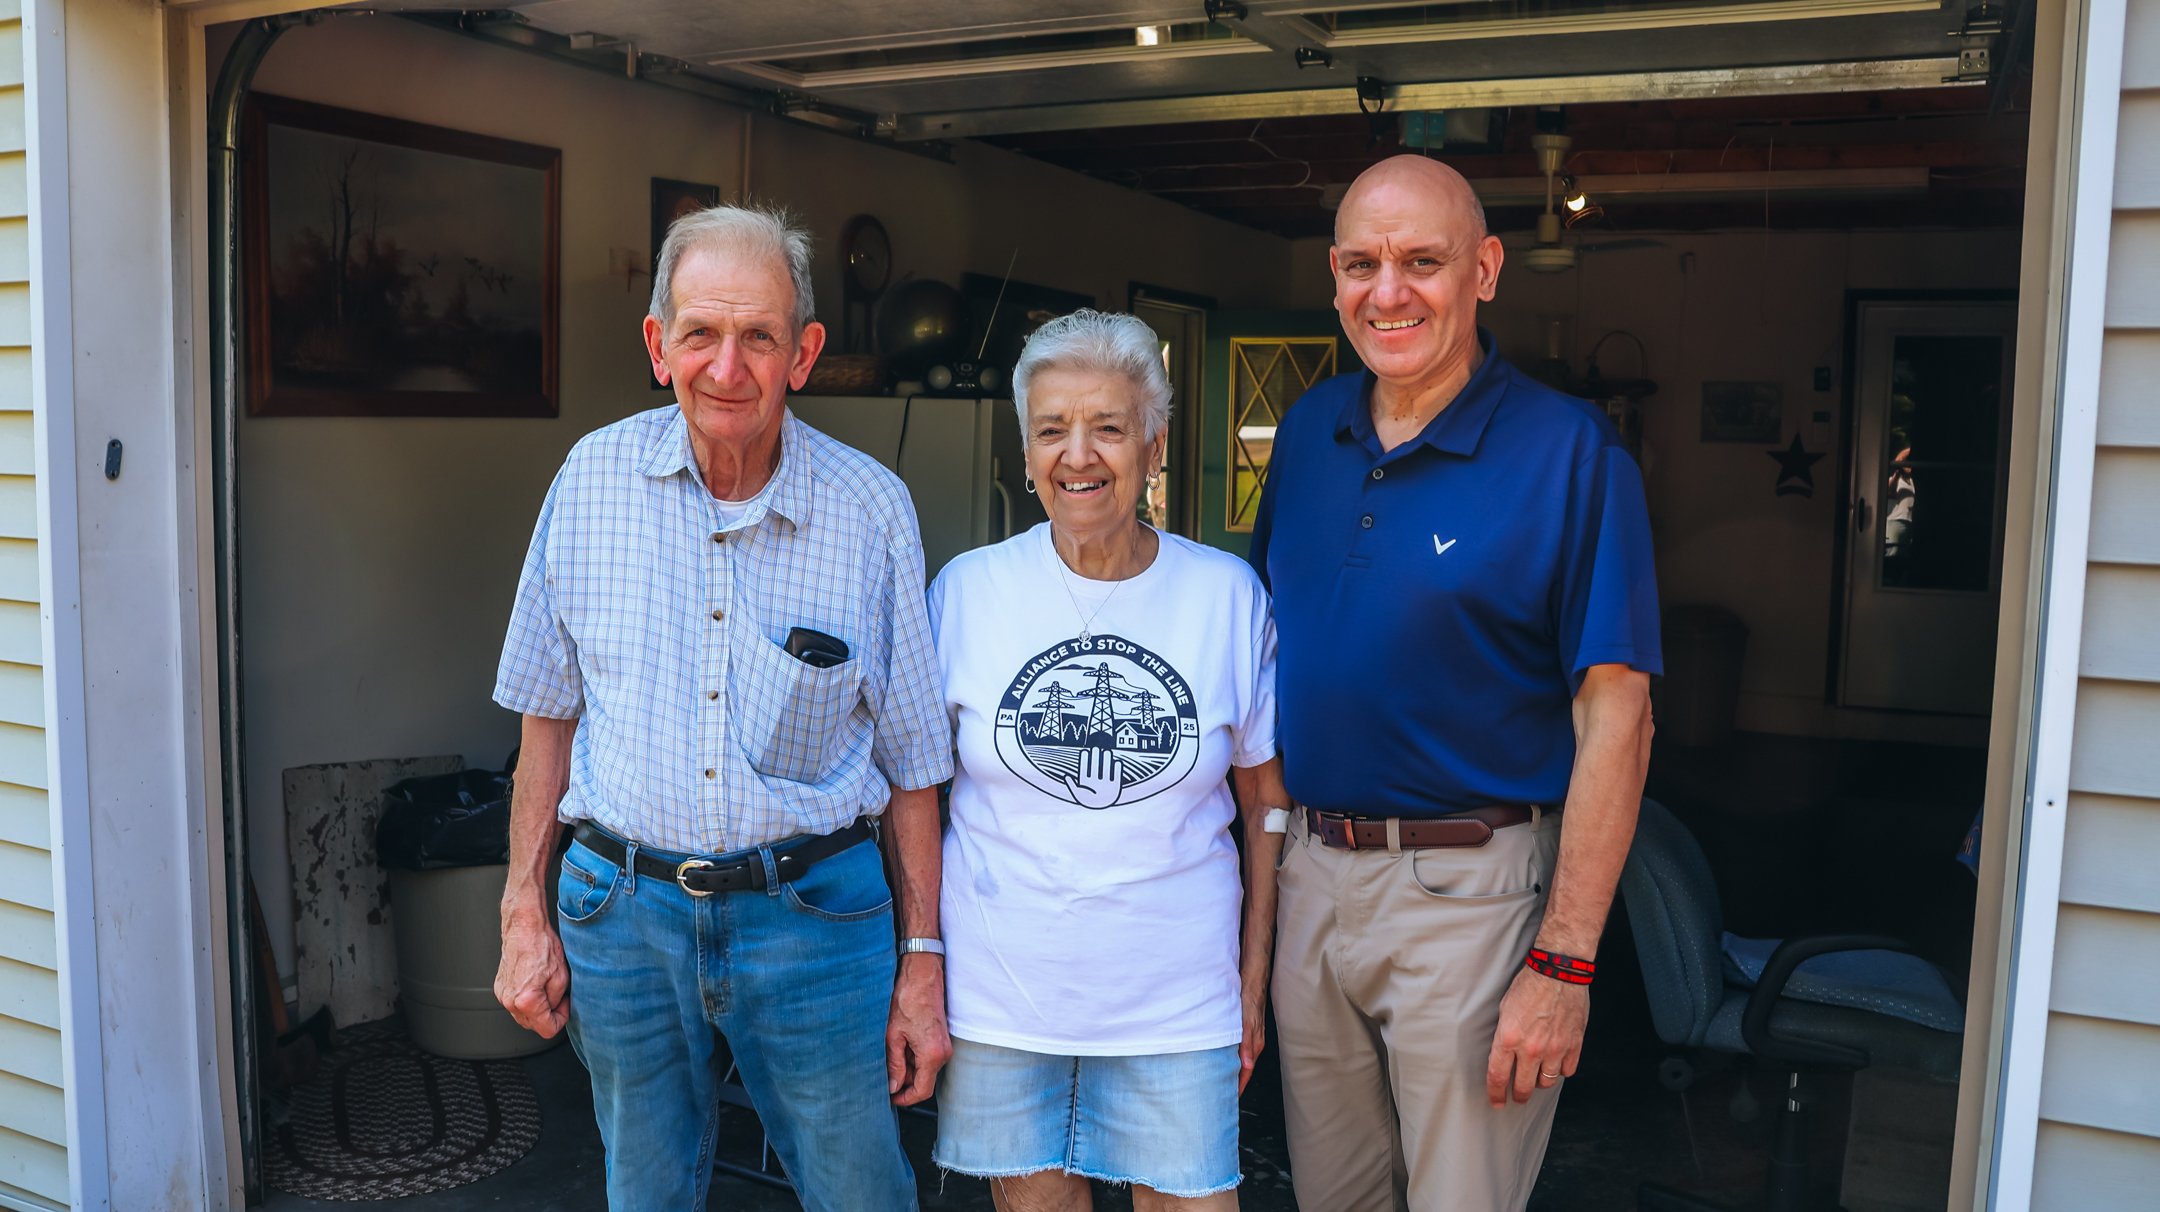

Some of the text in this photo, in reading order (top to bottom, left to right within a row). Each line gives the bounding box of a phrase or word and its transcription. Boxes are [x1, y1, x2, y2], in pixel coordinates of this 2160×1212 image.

[1011, 639, 1189, 705] ALLIANCE TO STOP THE LINE
[1183, 723, 1195, 731] 25
